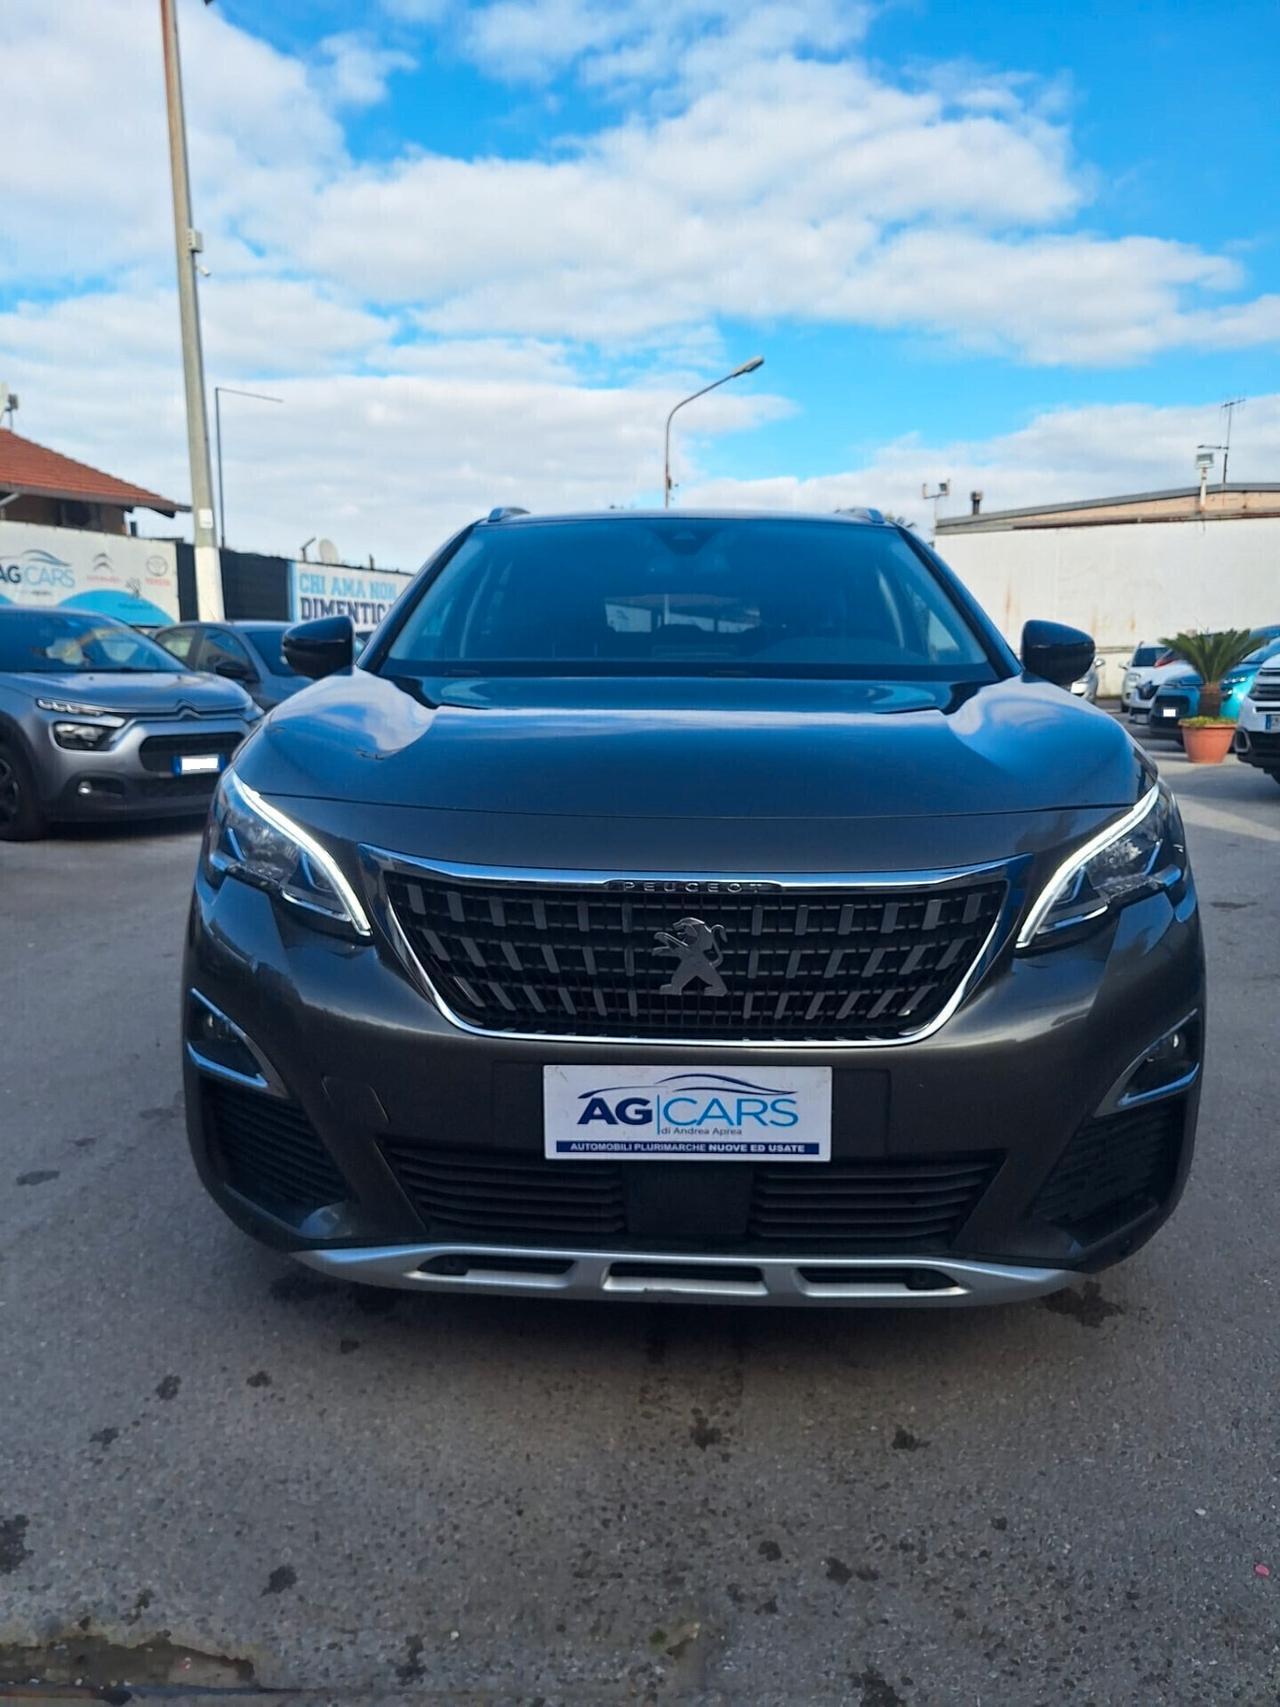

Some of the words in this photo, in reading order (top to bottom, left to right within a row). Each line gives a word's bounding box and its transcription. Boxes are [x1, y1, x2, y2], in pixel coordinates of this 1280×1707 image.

[24, 565, 76, 589] CARS
[299, 573, 325, 595] CHI
[331, 576, 366, 599] AMA
[370, 581, 397, 600] NON
[301, 597, 395, 625] DIMENTIC
[623, 881, 763, 893] PEUGEOT
[576, 1097, 653, 1125] AG
[663, 1097, 799, 1127] CARS
[661, 1127, 670, 1135] di
[673, 1127, 710, 1135] Andrea
[712, 1127, 742, 1137] Aprea
[570, 1143, 633, 1152] AUTOMOBILI
[634, 1143, 706, 1152] PLURIMARCHE
[708, 1143, 748, 1153] NUOVE
[751, 1144, 766, 1153] ED
[768, 1144, 805, 1153] USATE
